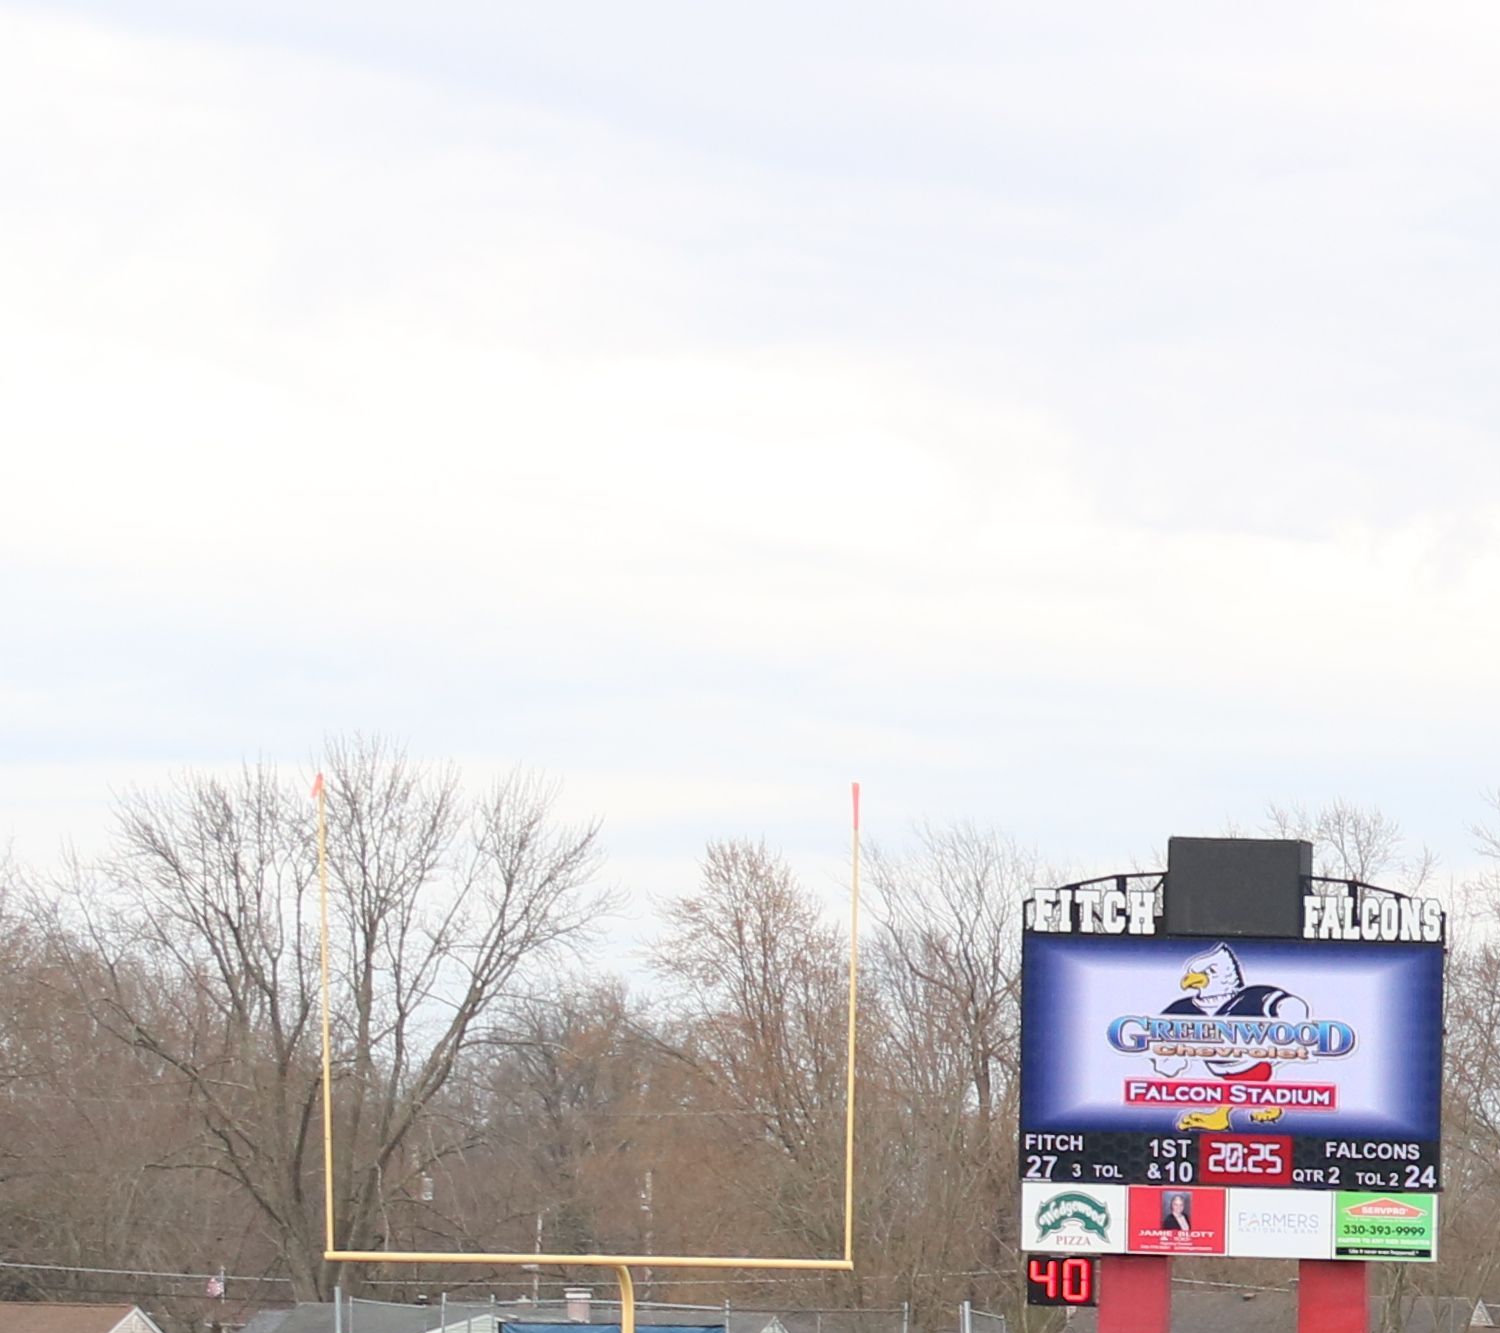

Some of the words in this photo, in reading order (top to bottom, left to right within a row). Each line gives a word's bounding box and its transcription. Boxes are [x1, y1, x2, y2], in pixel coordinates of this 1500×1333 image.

[1033, 888, 1156, 935] FITCH
[1303, 895, 1442, 942] FALCONS
[1107, 1015, 1356, 1057] GREENWOOD
[1152, 1044, 1310, 1060] Chevrolet
[1129, 1082, 1222, 1103] FALCON
[1229, 1083, 1330, 1105] STADIUM
[1025, 1134, 1083, 1152] FITCH
[1149, 1138, 1192, 1159] 1ST
[1325, 1141, 1420, 1161] FALCONS
[1026, 1155, 1058, 1179] 27
[1207, 1142, 1282, 1174] 20:25
[1071, 1163, 1082, 1178] 3
[1093, 1164, 1123, 1178] TOL
[1292, 1169, 1325, 1184] QTR
[1328, 1166, 1341, 1185] 2
[1355, 1172, 1386, 1186] TOL
[1389, 1172, 1399, 1187] 2
[1404, 1165, 1437, 1188] 24
[1039, 1200, 1106, 1227] Wedgewood
[1238, 1212, 1320, 1229] FARMERS
[1056, 1235, 1092, 1246] PIZZA
[1343, 1225, 1426, 1236] 330-393-9999
[1030, 1258, 1090, 1303] 40
